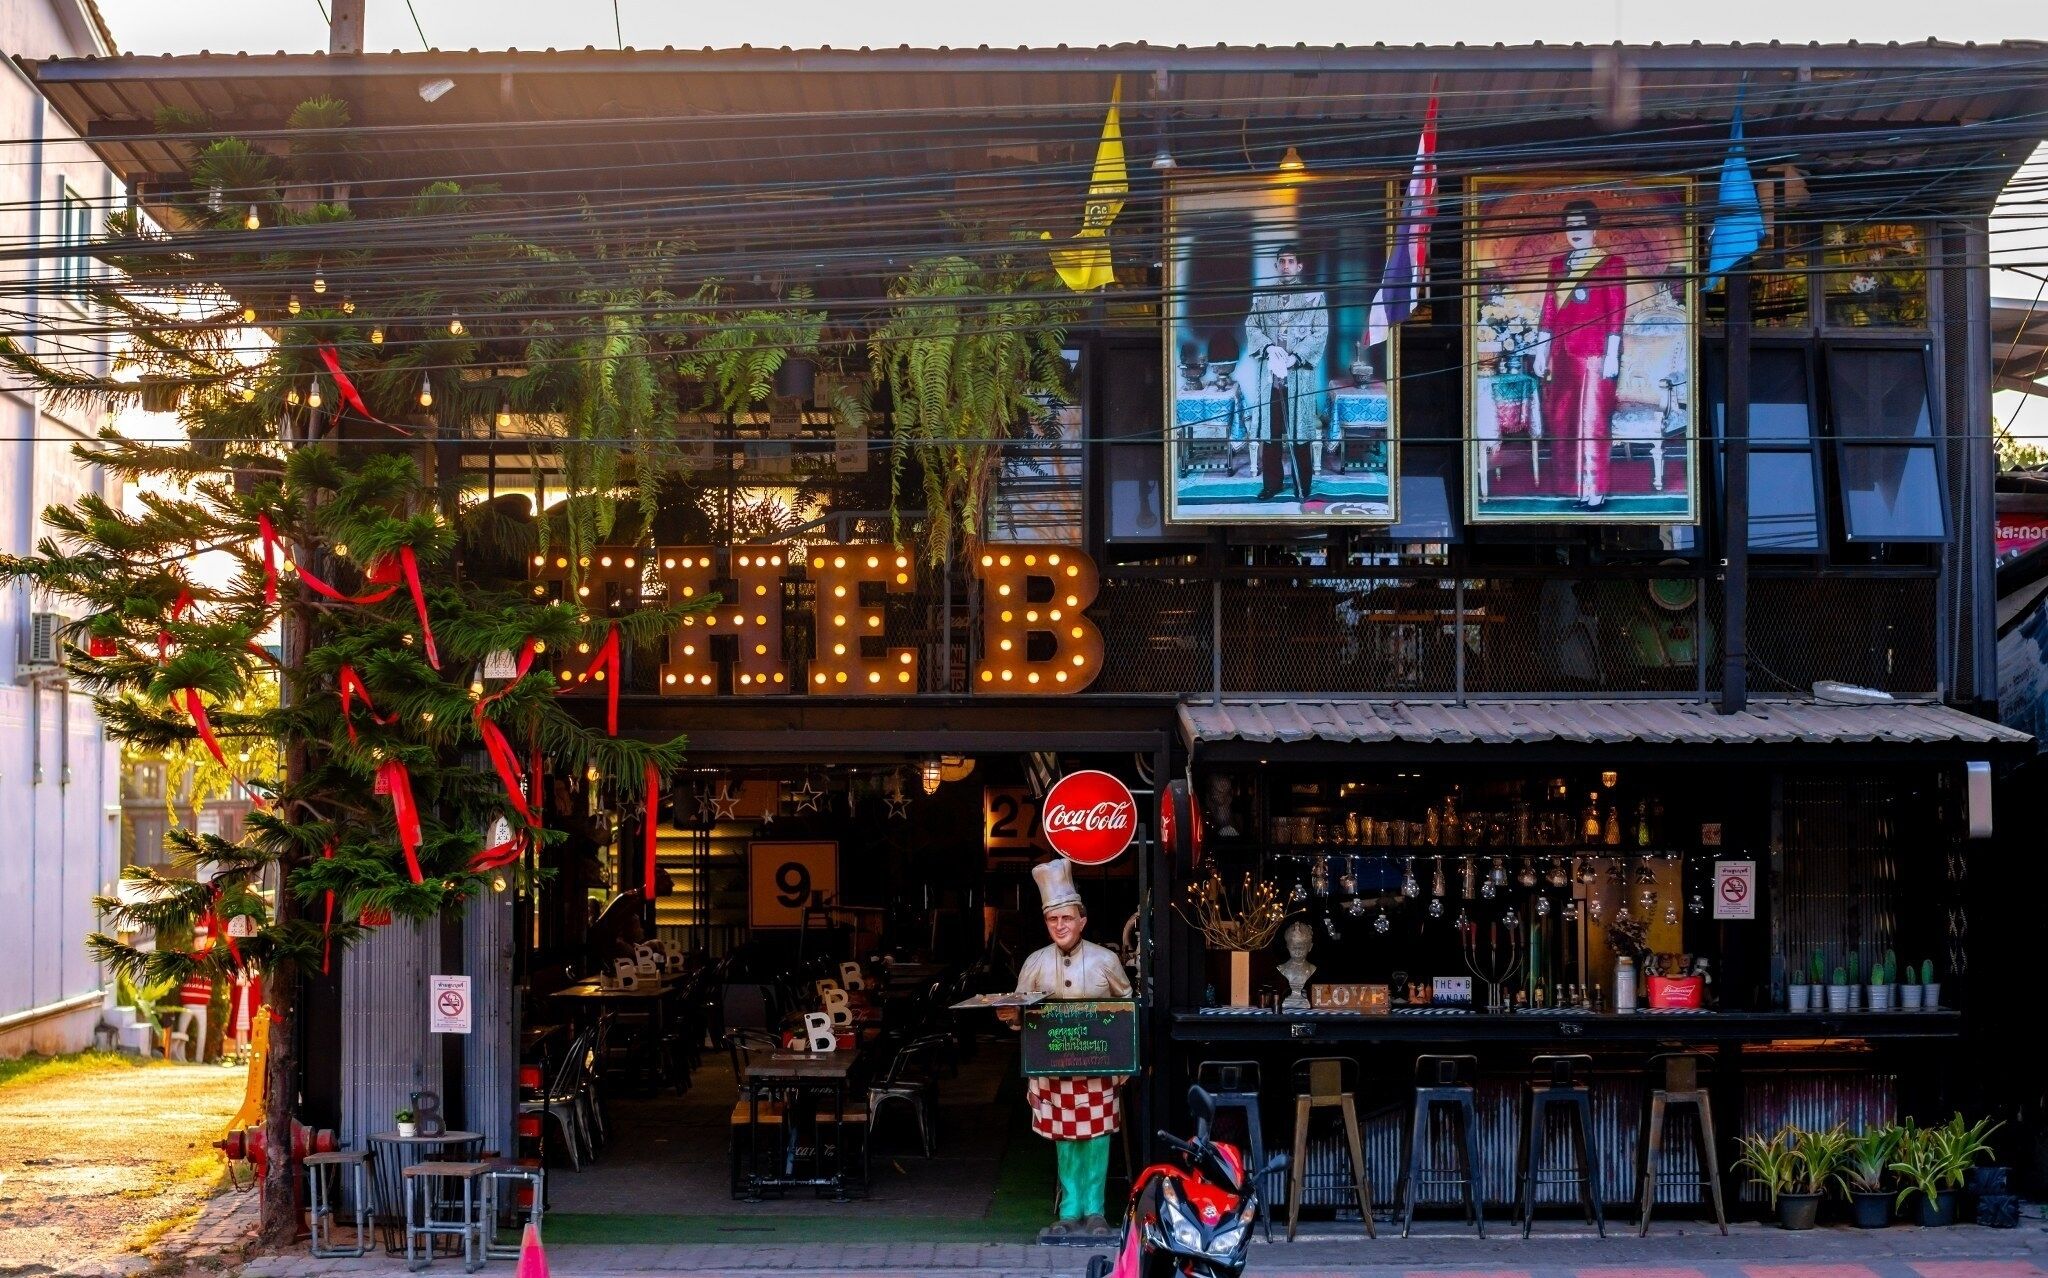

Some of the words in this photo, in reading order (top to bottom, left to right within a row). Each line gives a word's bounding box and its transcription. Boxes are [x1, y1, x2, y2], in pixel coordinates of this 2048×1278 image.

[529, 545, 919, 696] THE
[973, 544, 1104, 694] B
[1045, 801, 1132, 834] Coca-Cola
[775, 861, 812, 908] 9
[1313, 985, 1388, 1007] LOVE
[1434, 979, 1452, 990] THE
[823, 989, 853, 1027] B
[804, 1012, 838, 1053] B
[410, 1091, 446, 1137] B
